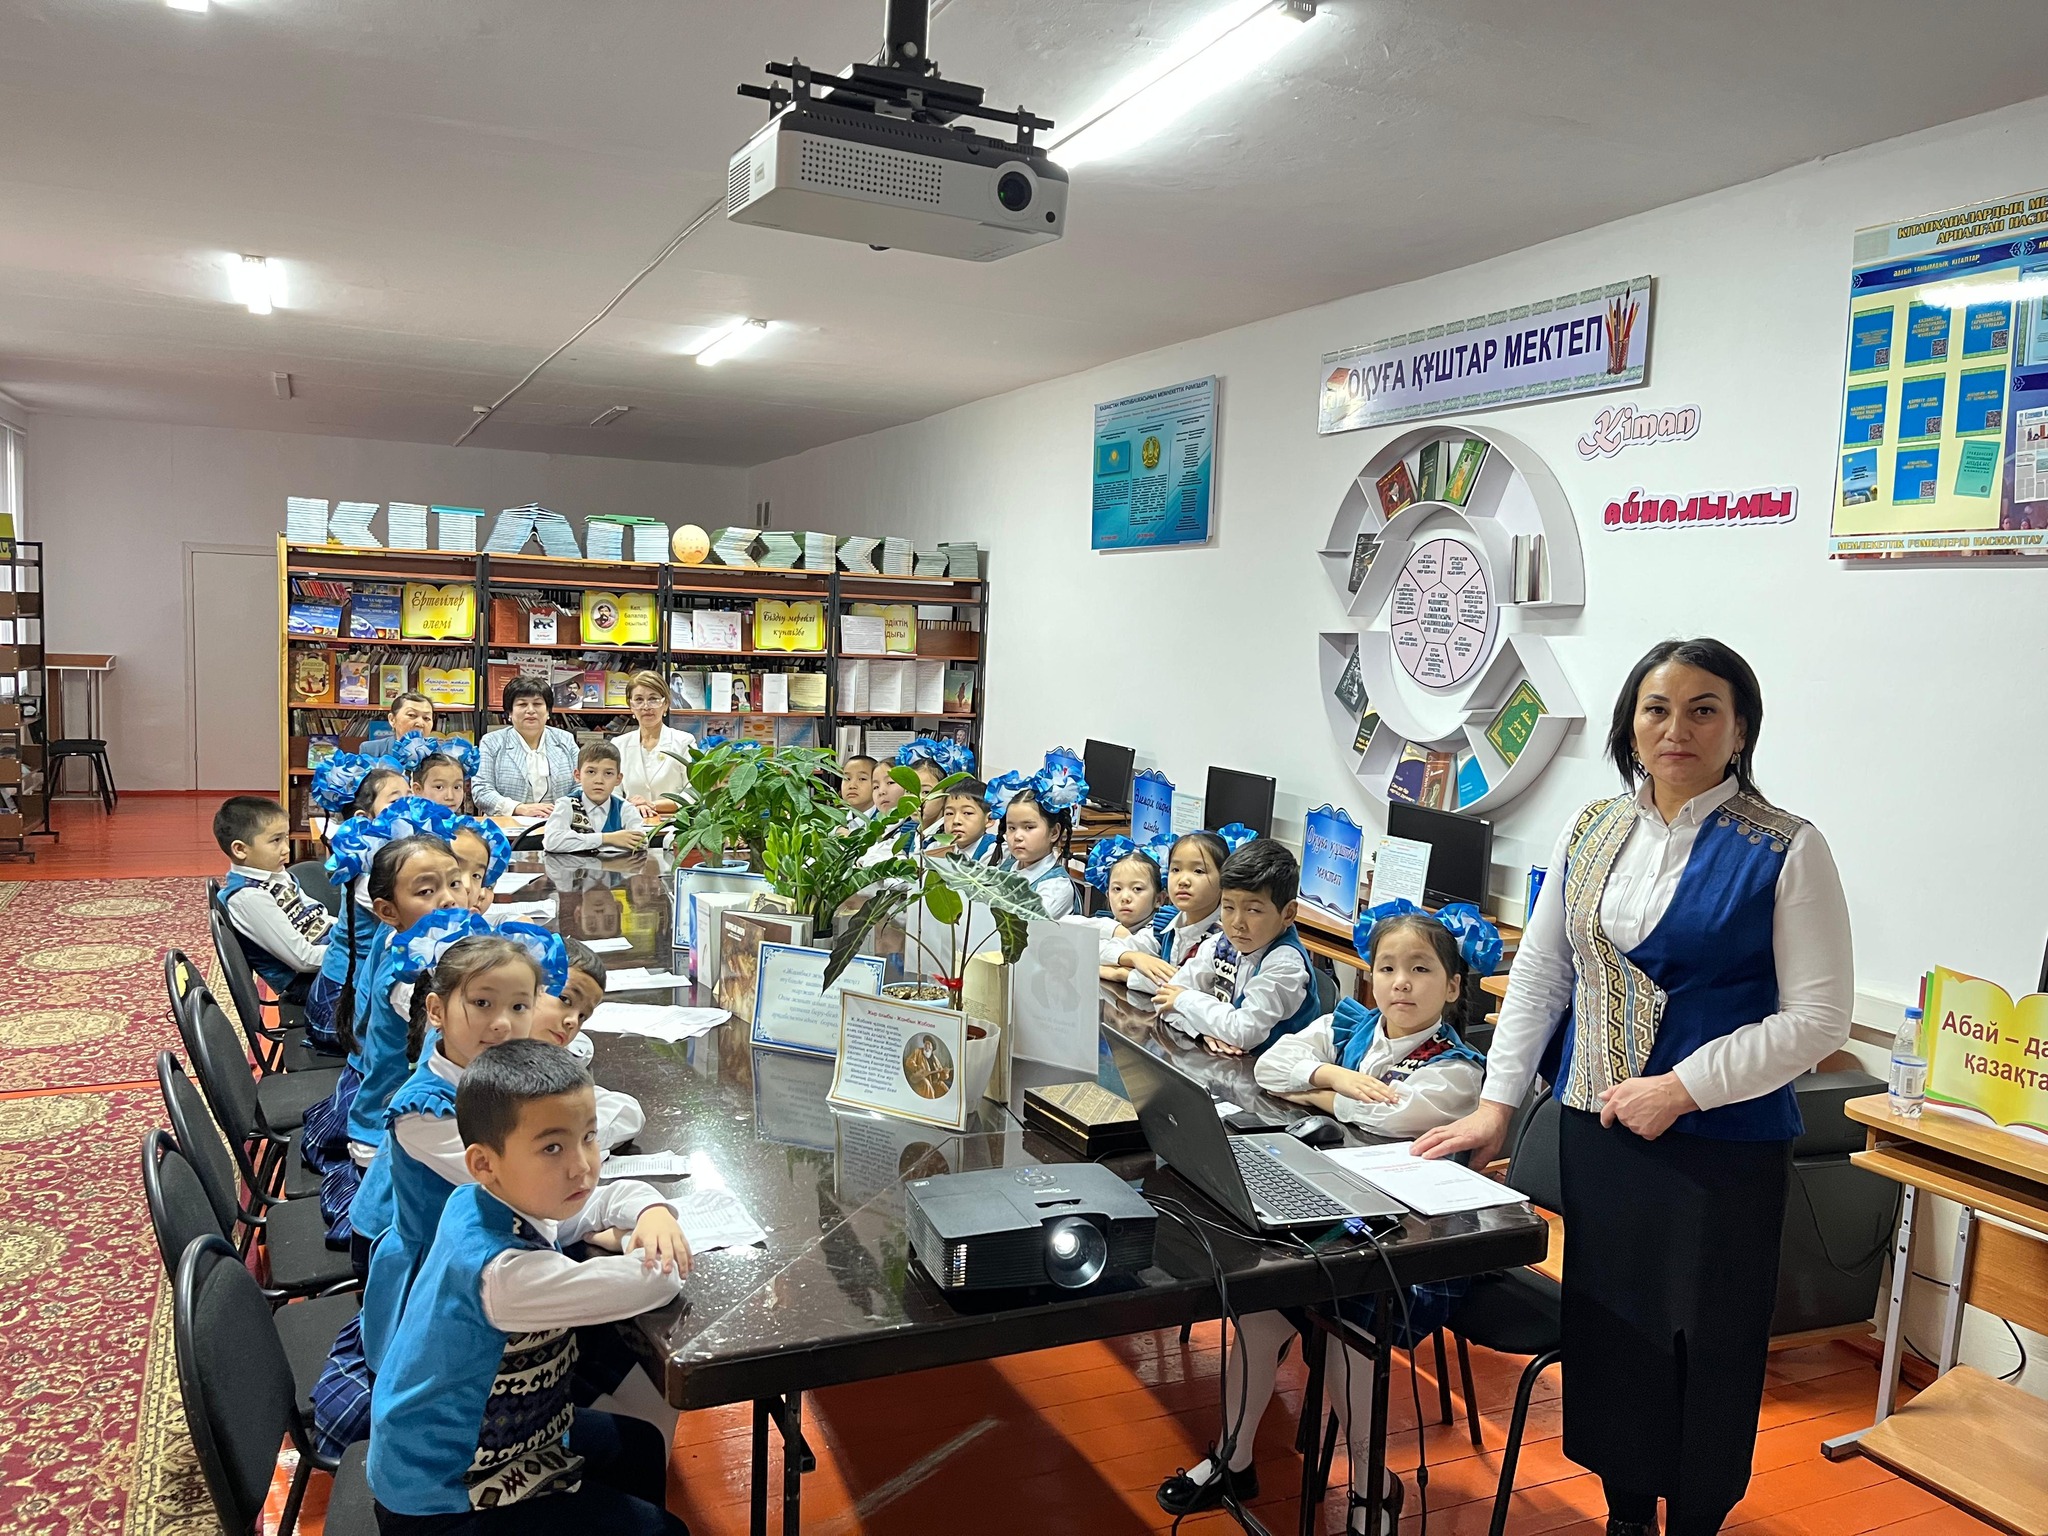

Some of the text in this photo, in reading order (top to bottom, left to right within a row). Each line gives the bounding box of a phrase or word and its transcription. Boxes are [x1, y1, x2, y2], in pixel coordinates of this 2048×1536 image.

[1898, 200, 2024, 239] КІТАПХАНАЛАРДЫҢ
[1936, 217, 2004, 244] АРНАЛҒАН
[1348, 315, 1603, 402] ОҚУҒА ҚҰШТАР МЕКТЕП
[1578, 404, 1695, 455] Кітап
[1604, 491, 1793, 526] айналымы
[412, 590, 465, 612] Ертегілер
[423, 617, 453, 630] әлемі
[1315, 866, 1342, 887] мектеп
[1942, 1010, 1999, 1044] Абай
